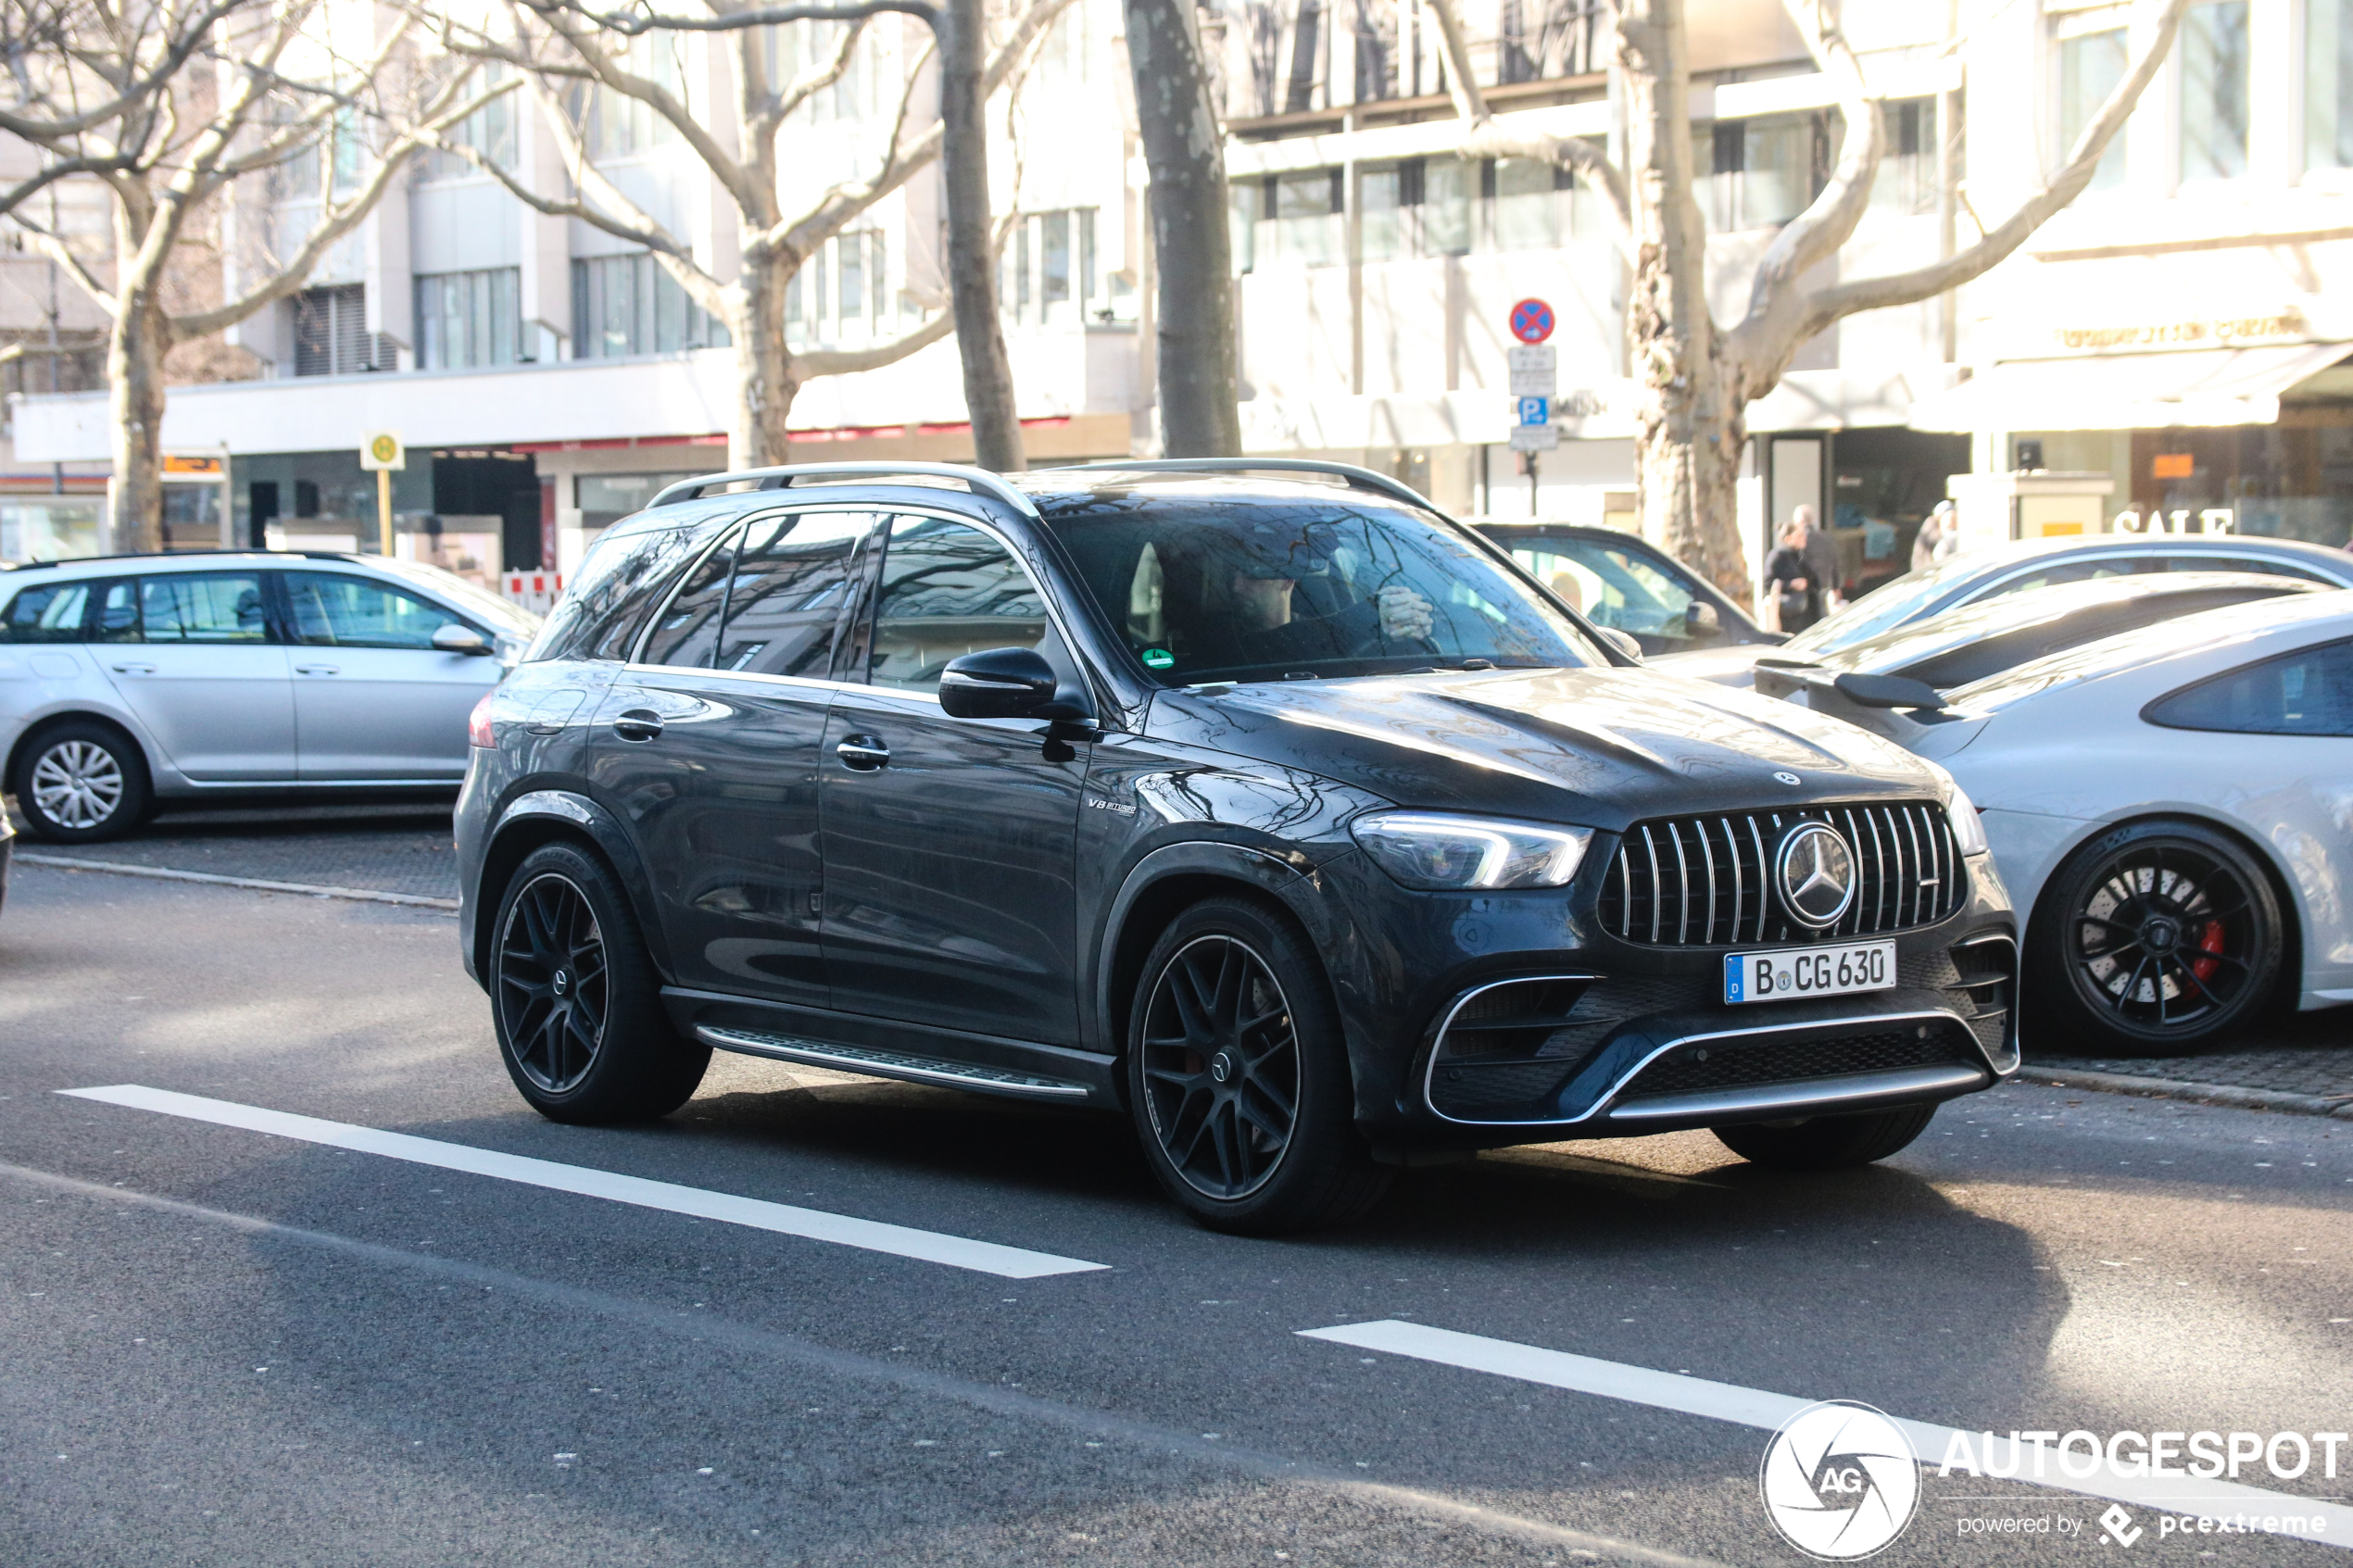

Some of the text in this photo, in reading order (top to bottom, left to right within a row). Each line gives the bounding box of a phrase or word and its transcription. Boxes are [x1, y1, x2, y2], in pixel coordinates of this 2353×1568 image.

[1522, 398, 1541, 422] P
[1152, 649, 1162, 659] 4
[1088, 798, 1136, 812] V8 BITURBO
[1755, 948, 1884, 995] B CG 630
[1731, 983, 1739, 994] D
